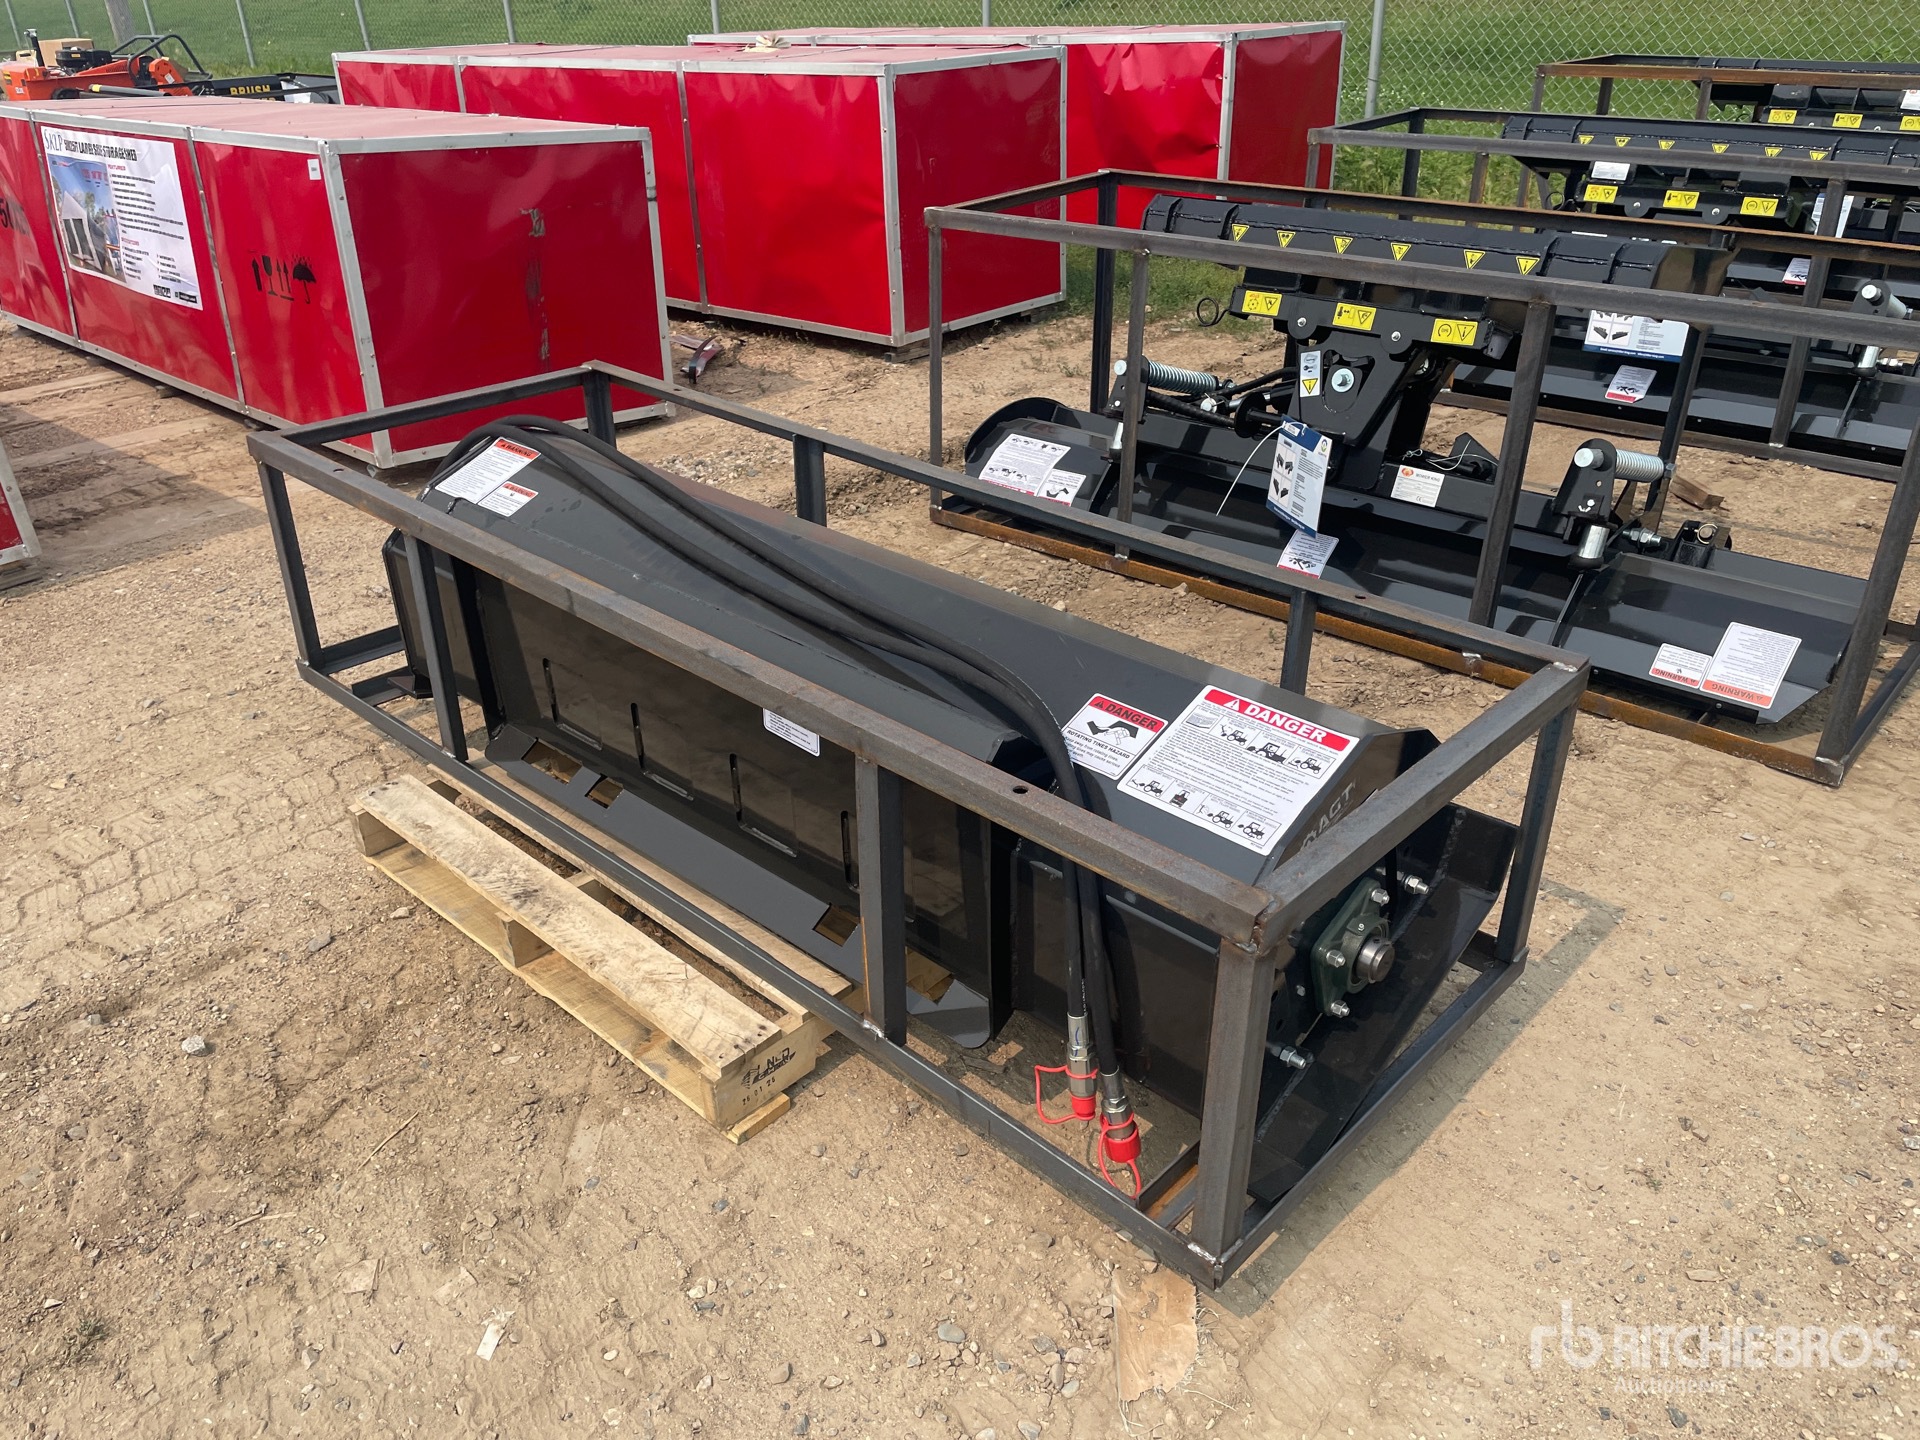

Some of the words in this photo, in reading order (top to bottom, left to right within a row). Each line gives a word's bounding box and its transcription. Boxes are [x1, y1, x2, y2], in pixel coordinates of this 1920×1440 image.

[1655, 668, 1692, 684] WARNING
[1711, 684, 1754, 701] WARNING
[1105, 703, 1158, 730] DANGER
[1244, 704, 1327, 743] DANGER
[1067, 729, 1092, 743] ROTATING
[1093, 740, 1108, 750] TINES
[1109, 747, 1131, 759] HAZARD
